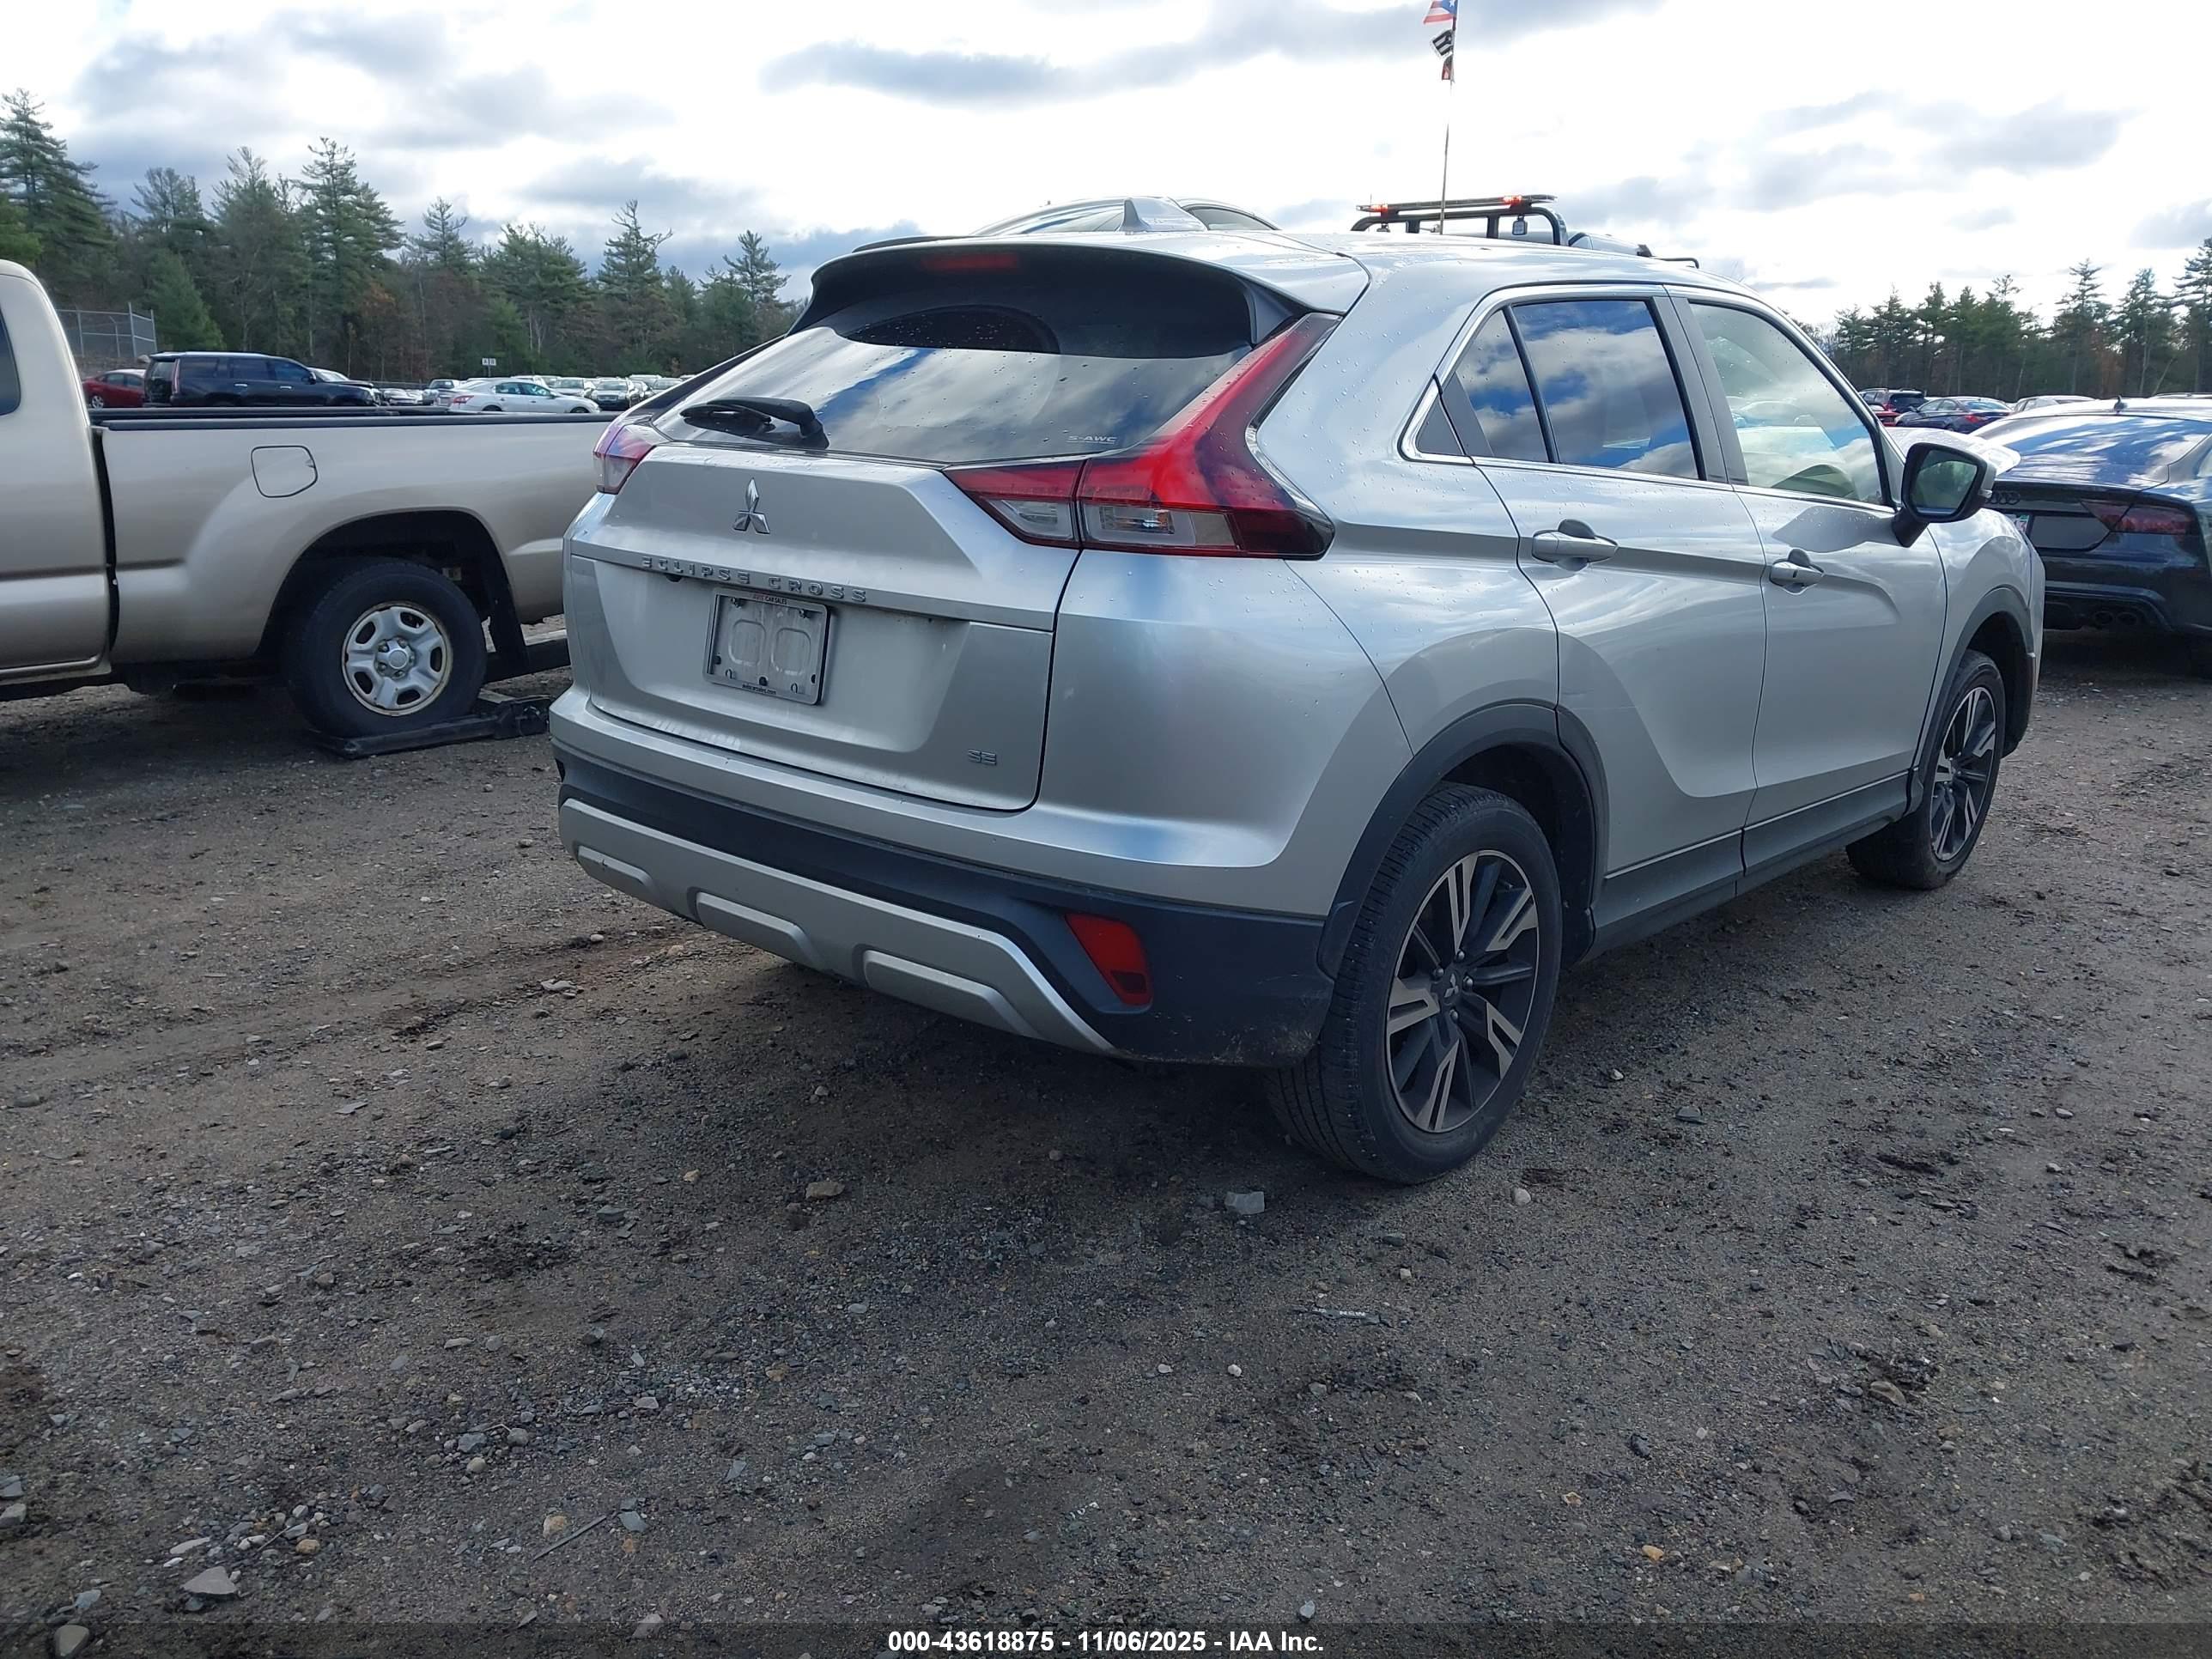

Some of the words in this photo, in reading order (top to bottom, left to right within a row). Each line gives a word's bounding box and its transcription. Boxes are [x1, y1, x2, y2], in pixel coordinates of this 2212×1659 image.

[641, 556, 750, 585] ECLIPSE
[769, 576, 866, 603] CROSS
[967, 749, 997, 766] SE
